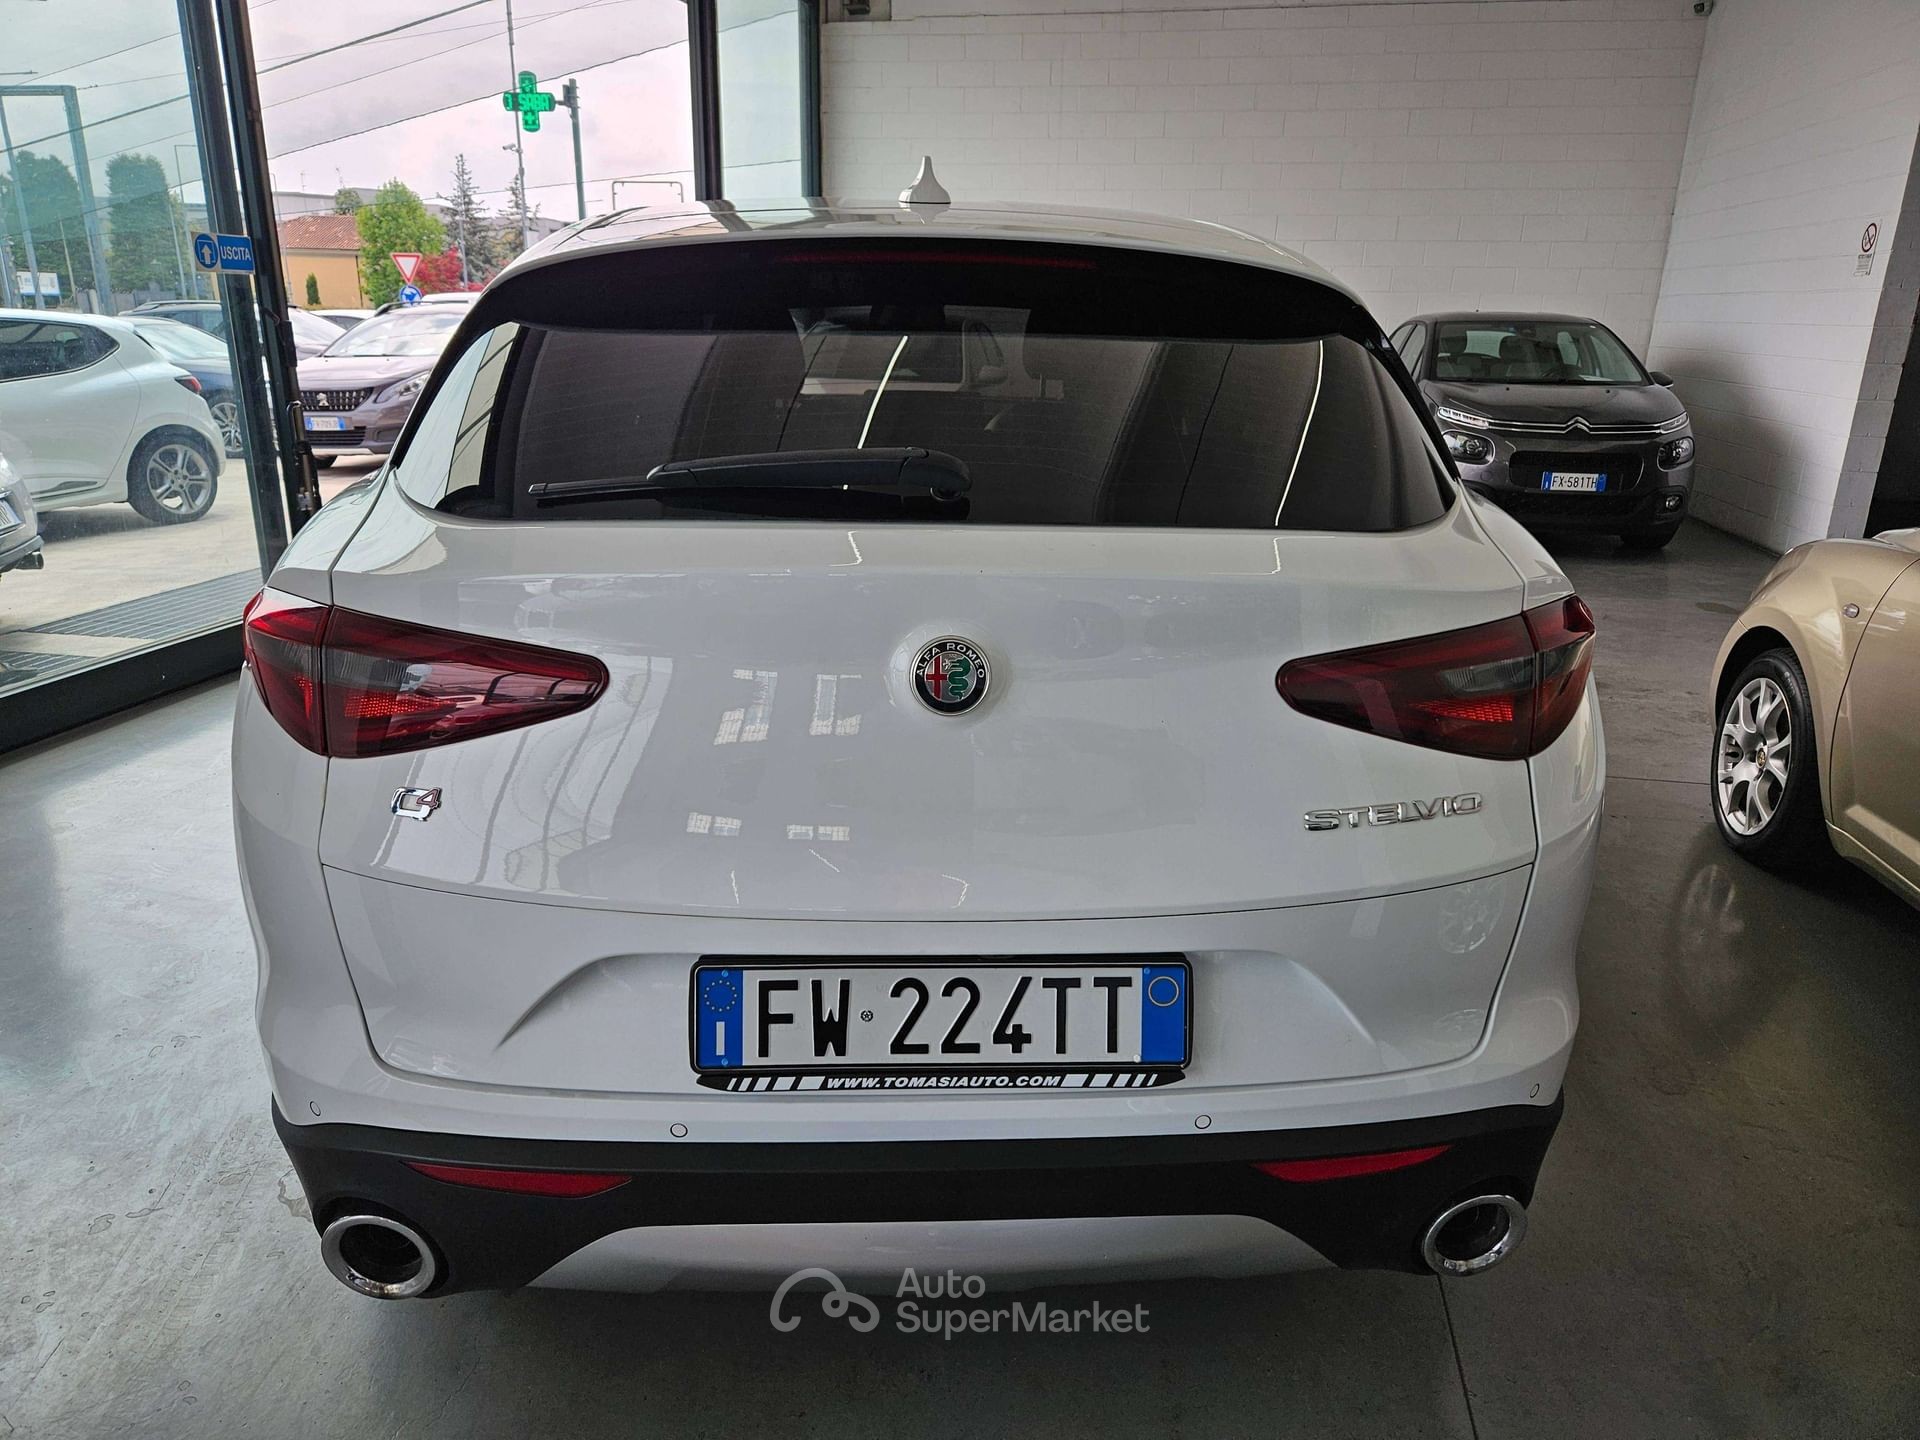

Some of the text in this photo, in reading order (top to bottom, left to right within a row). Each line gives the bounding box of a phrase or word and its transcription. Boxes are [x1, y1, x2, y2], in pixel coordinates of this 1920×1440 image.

[220, 245, 252, 261] USCITA
[916, 642, 985, 678] ALFA ROMEO
[1304, 792, 1483, 831] STELVIO
[758, 976, 1132, 1057] FW 224TT
[716, 1021, 725, 1056] I
[826, 1075, 1061, 1089] WWW.TOMASIAUTO.COM
